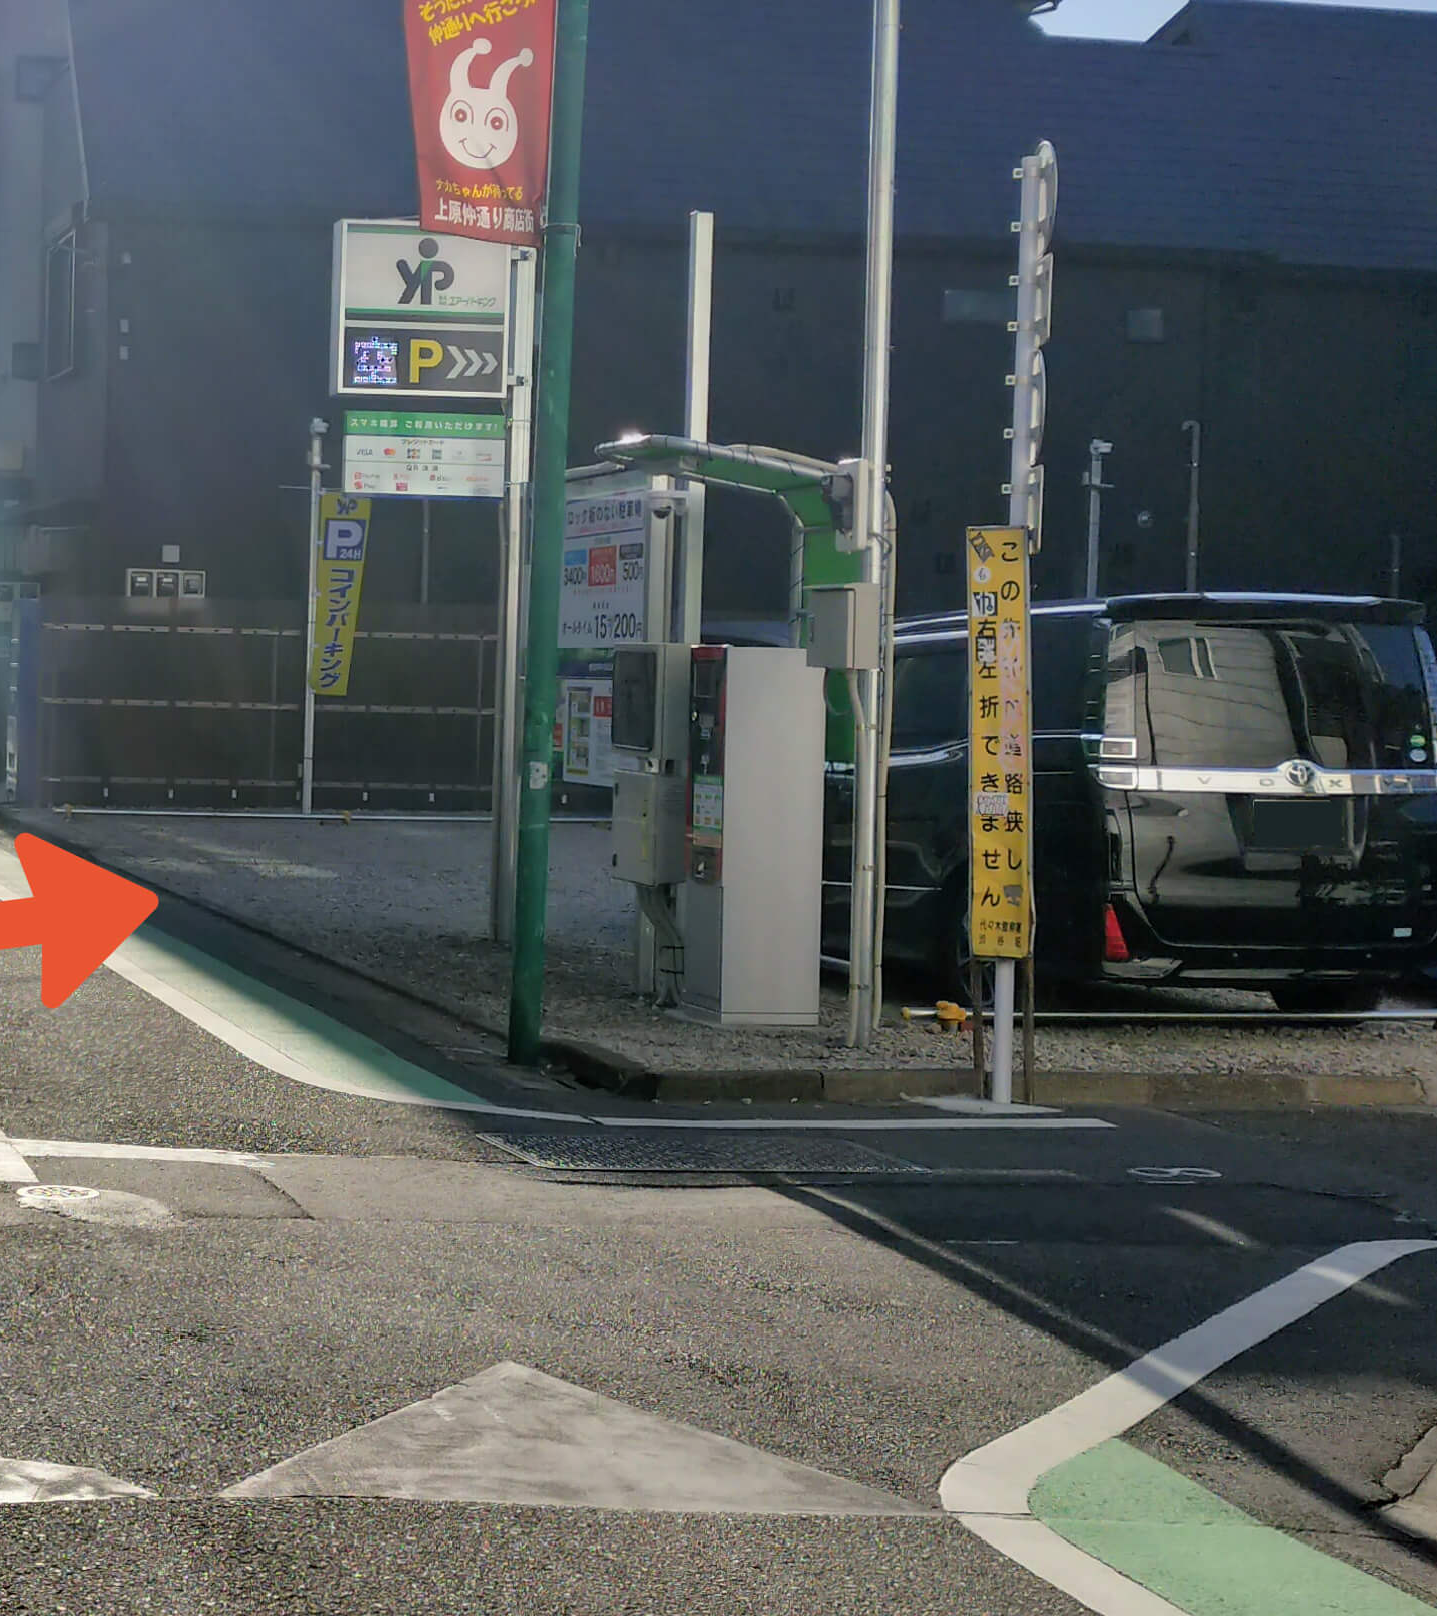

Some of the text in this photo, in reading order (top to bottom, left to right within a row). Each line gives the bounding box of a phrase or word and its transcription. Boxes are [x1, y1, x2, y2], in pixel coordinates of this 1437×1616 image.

[409, 339, 444, 383] P
[325, 519, 363, 559] P
[318, 567, 356, 689] コインパーキング
